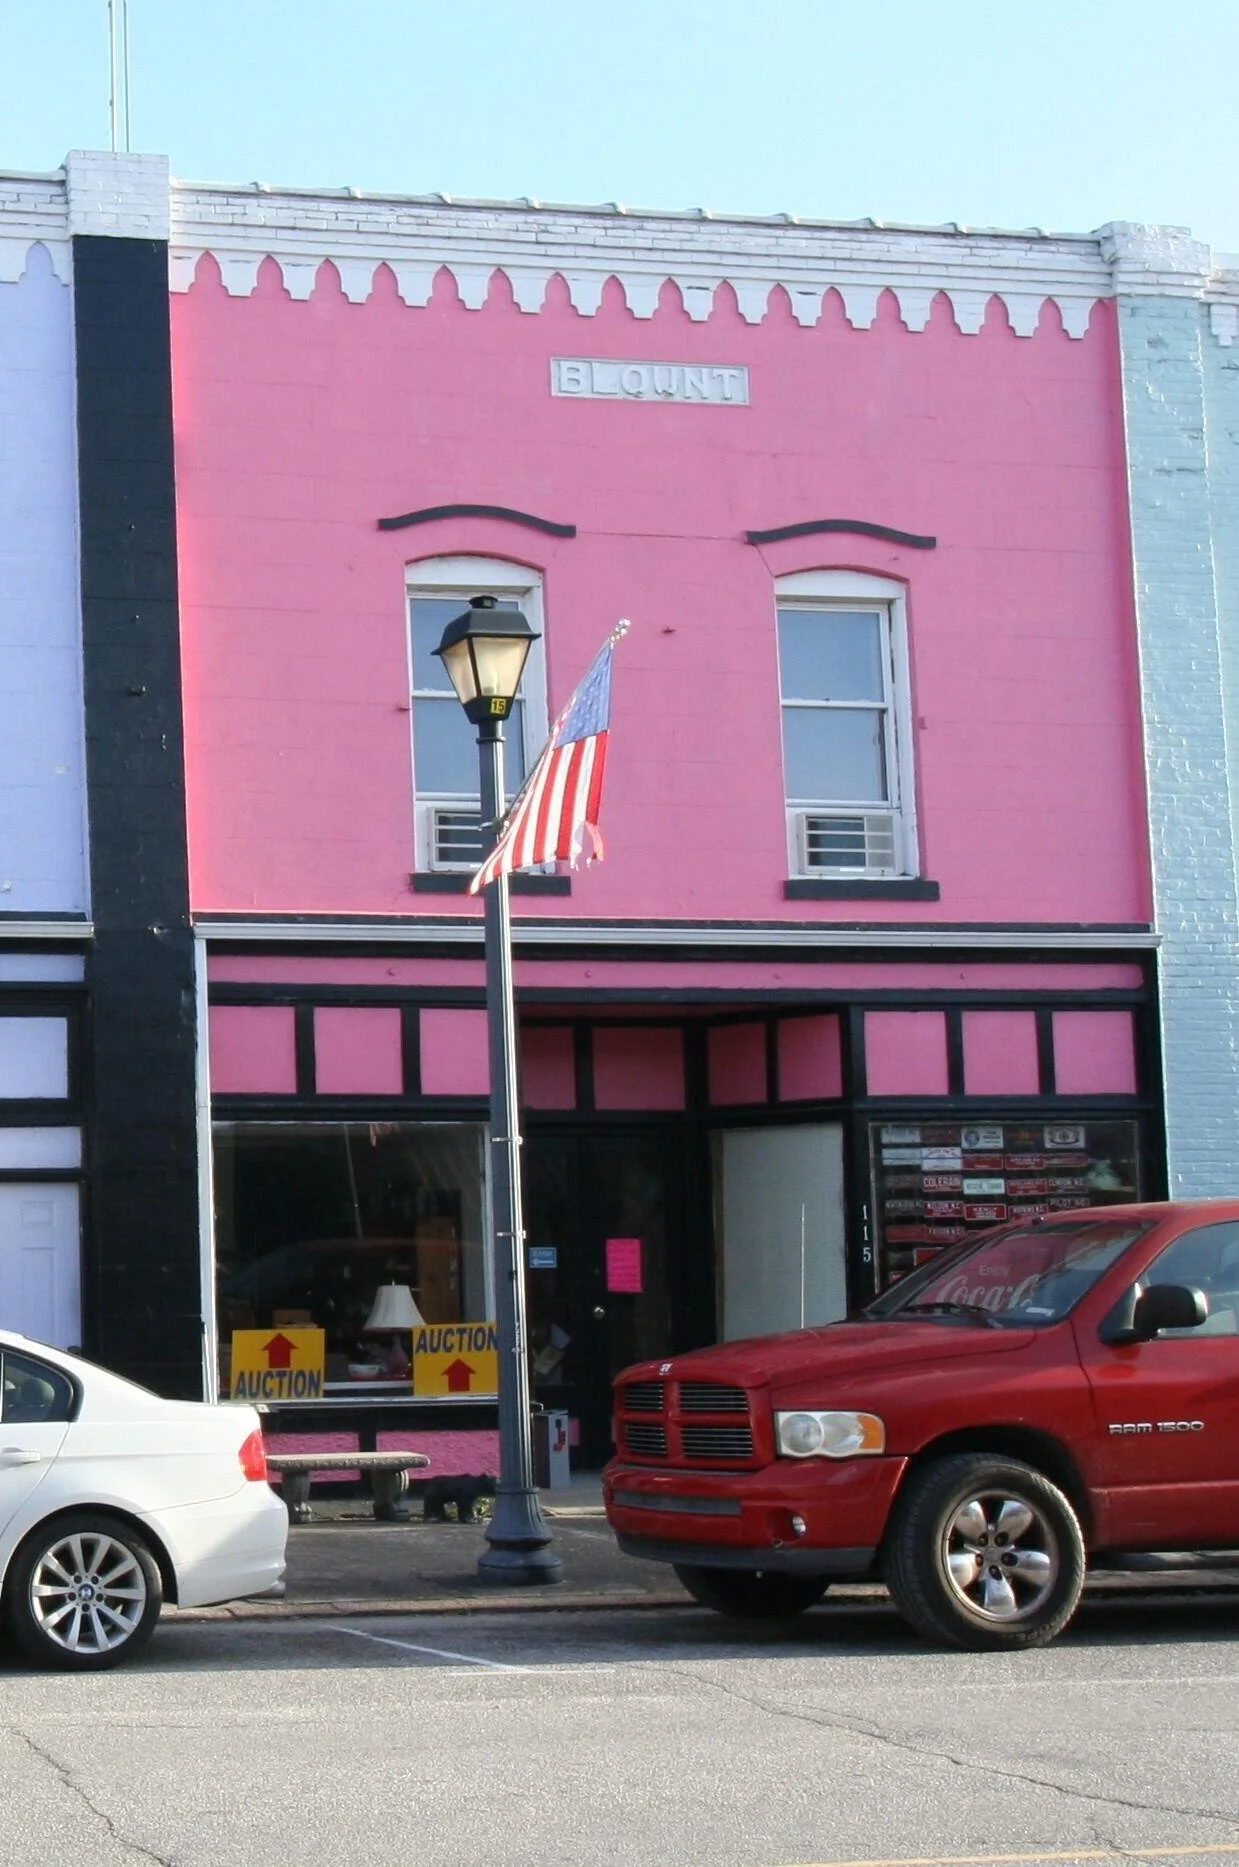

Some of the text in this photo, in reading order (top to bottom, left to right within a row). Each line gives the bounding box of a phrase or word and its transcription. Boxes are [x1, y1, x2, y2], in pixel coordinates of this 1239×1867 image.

[558, 360, 741, 400] BLOUNT
[493, 699, 506, 713] 15
[978, 1264, 1010, 1278] Enjoy
[235, 1368, 321, 1399] AUCTION
[1108, 1420, 1205, 1435] RAM 1500
